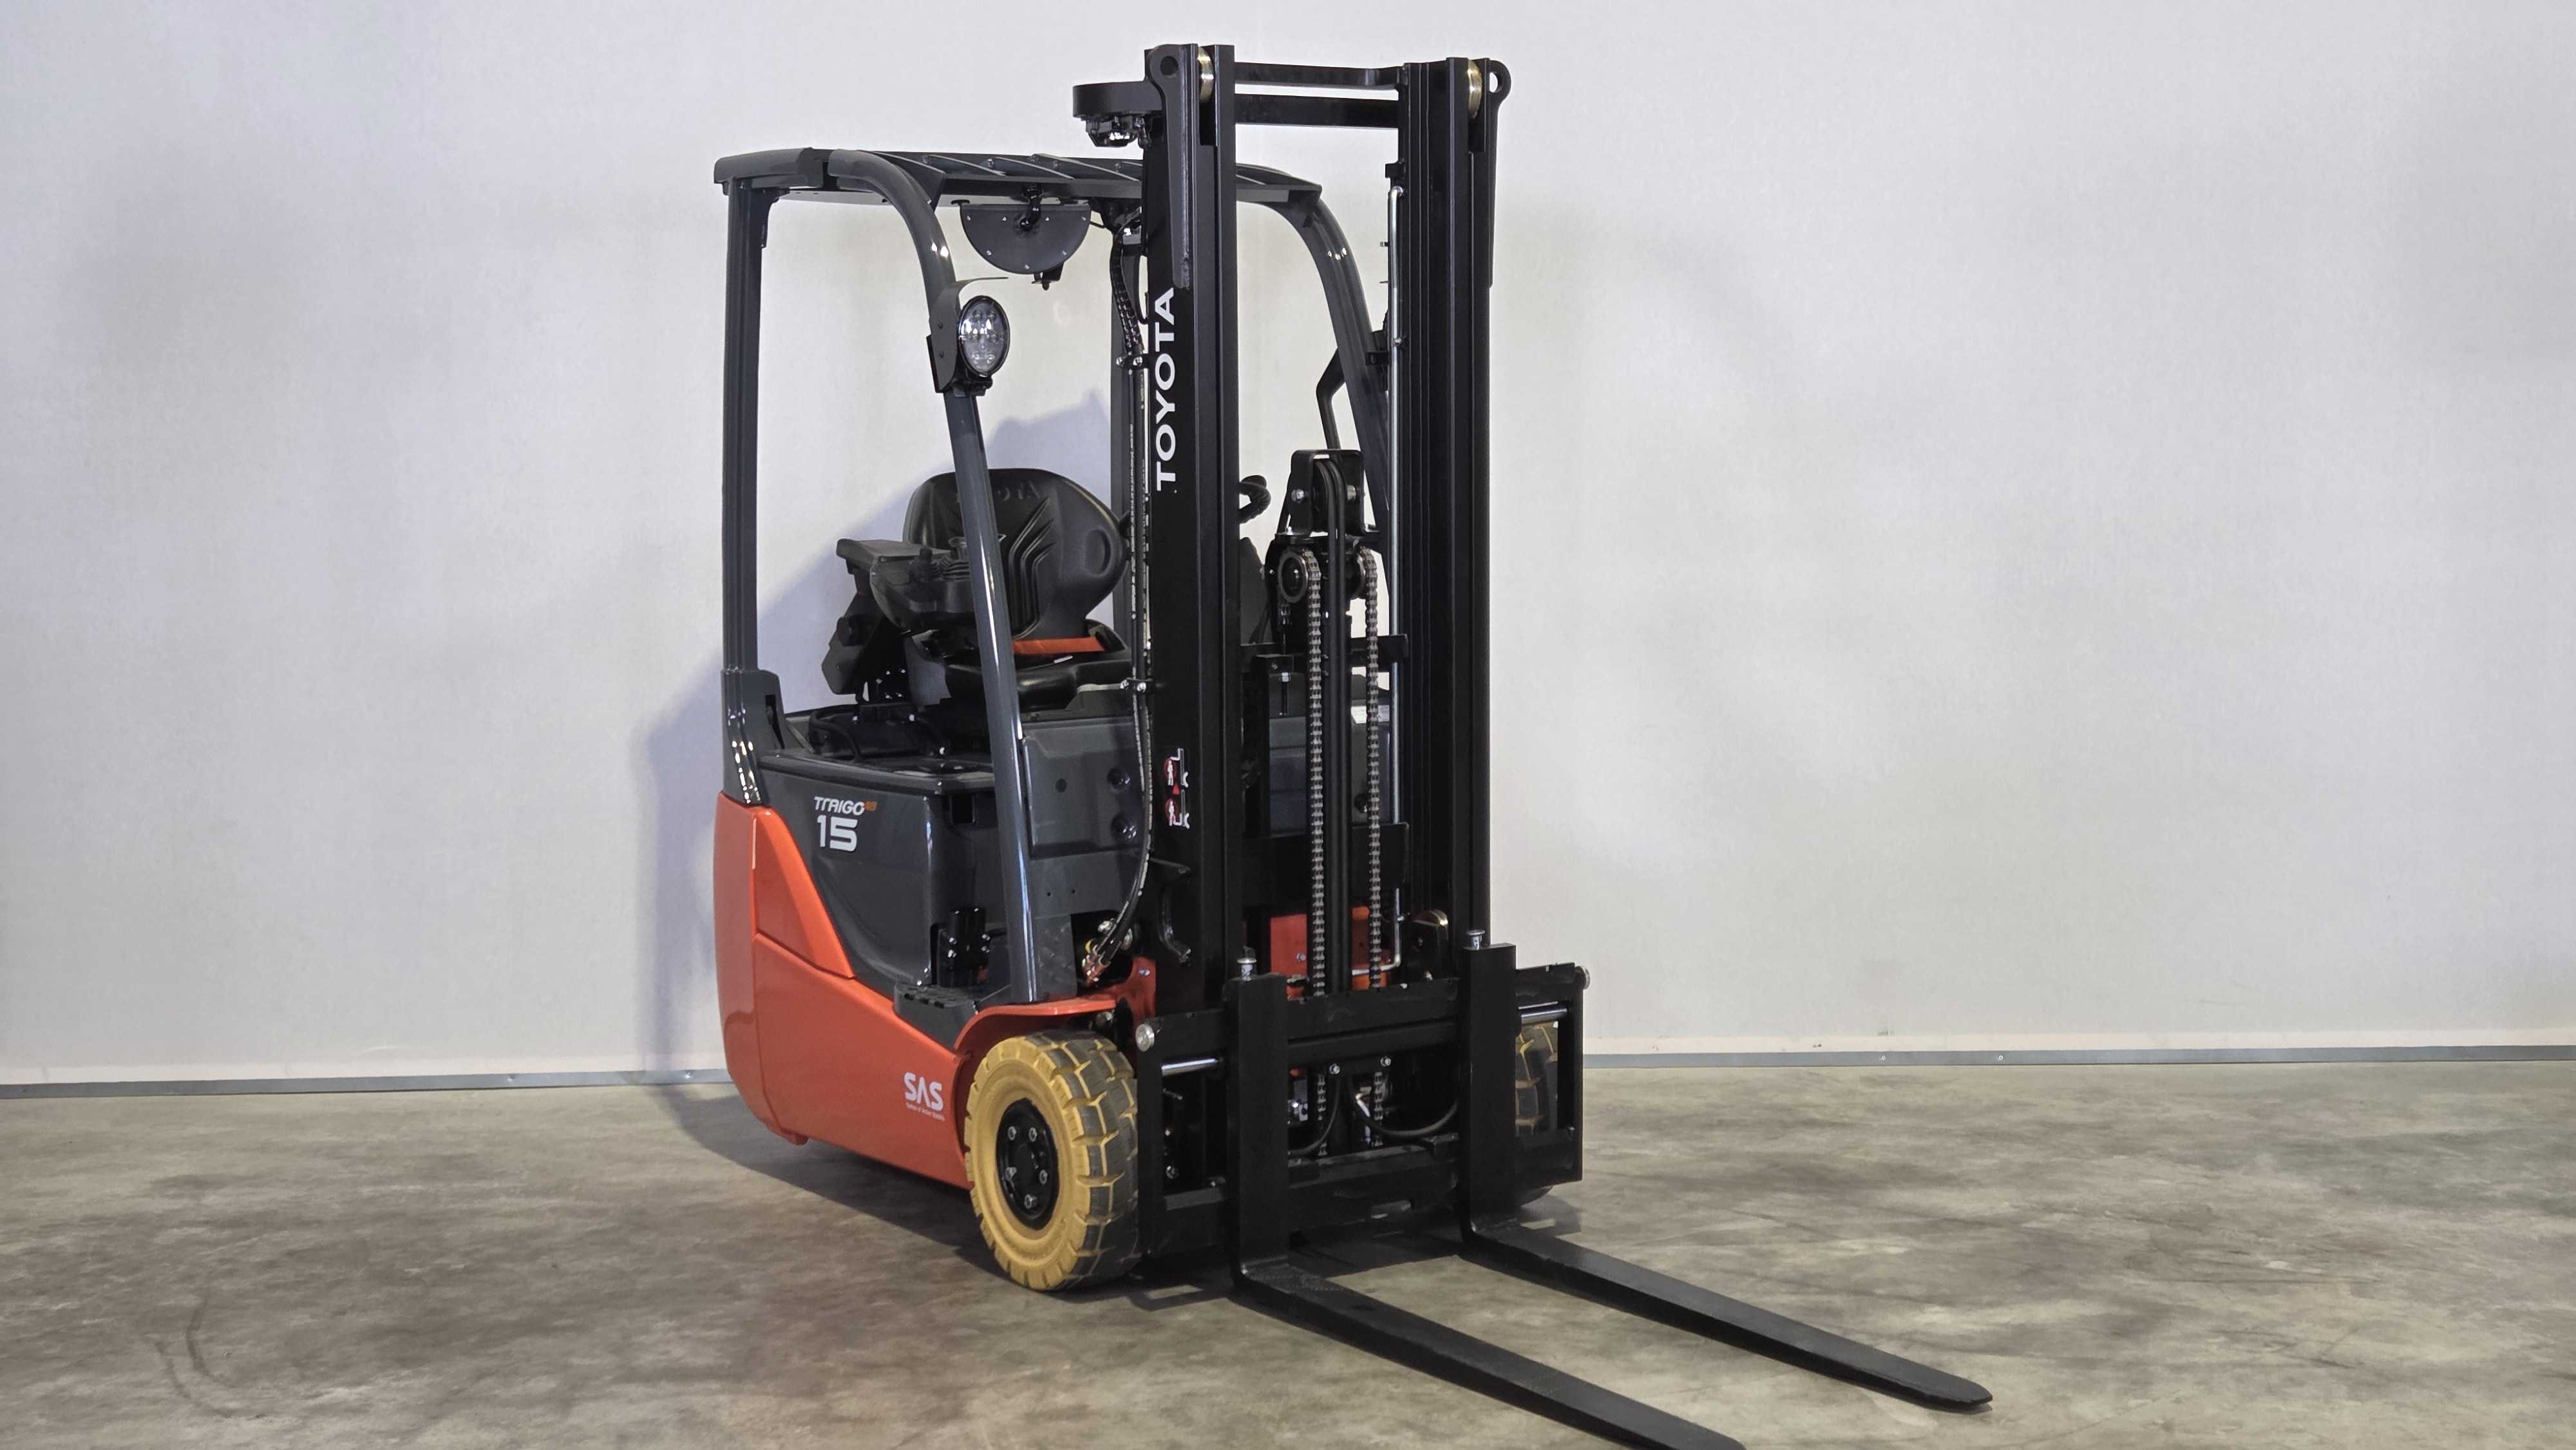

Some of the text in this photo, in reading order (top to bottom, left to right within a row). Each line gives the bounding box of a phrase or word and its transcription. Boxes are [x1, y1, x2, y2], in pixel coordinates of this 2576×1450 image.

[1155, 287, 1176, 491] TOYOTA
[817, 814, 858, 852] 15
[904, 1072, 943, 1111] SAS
